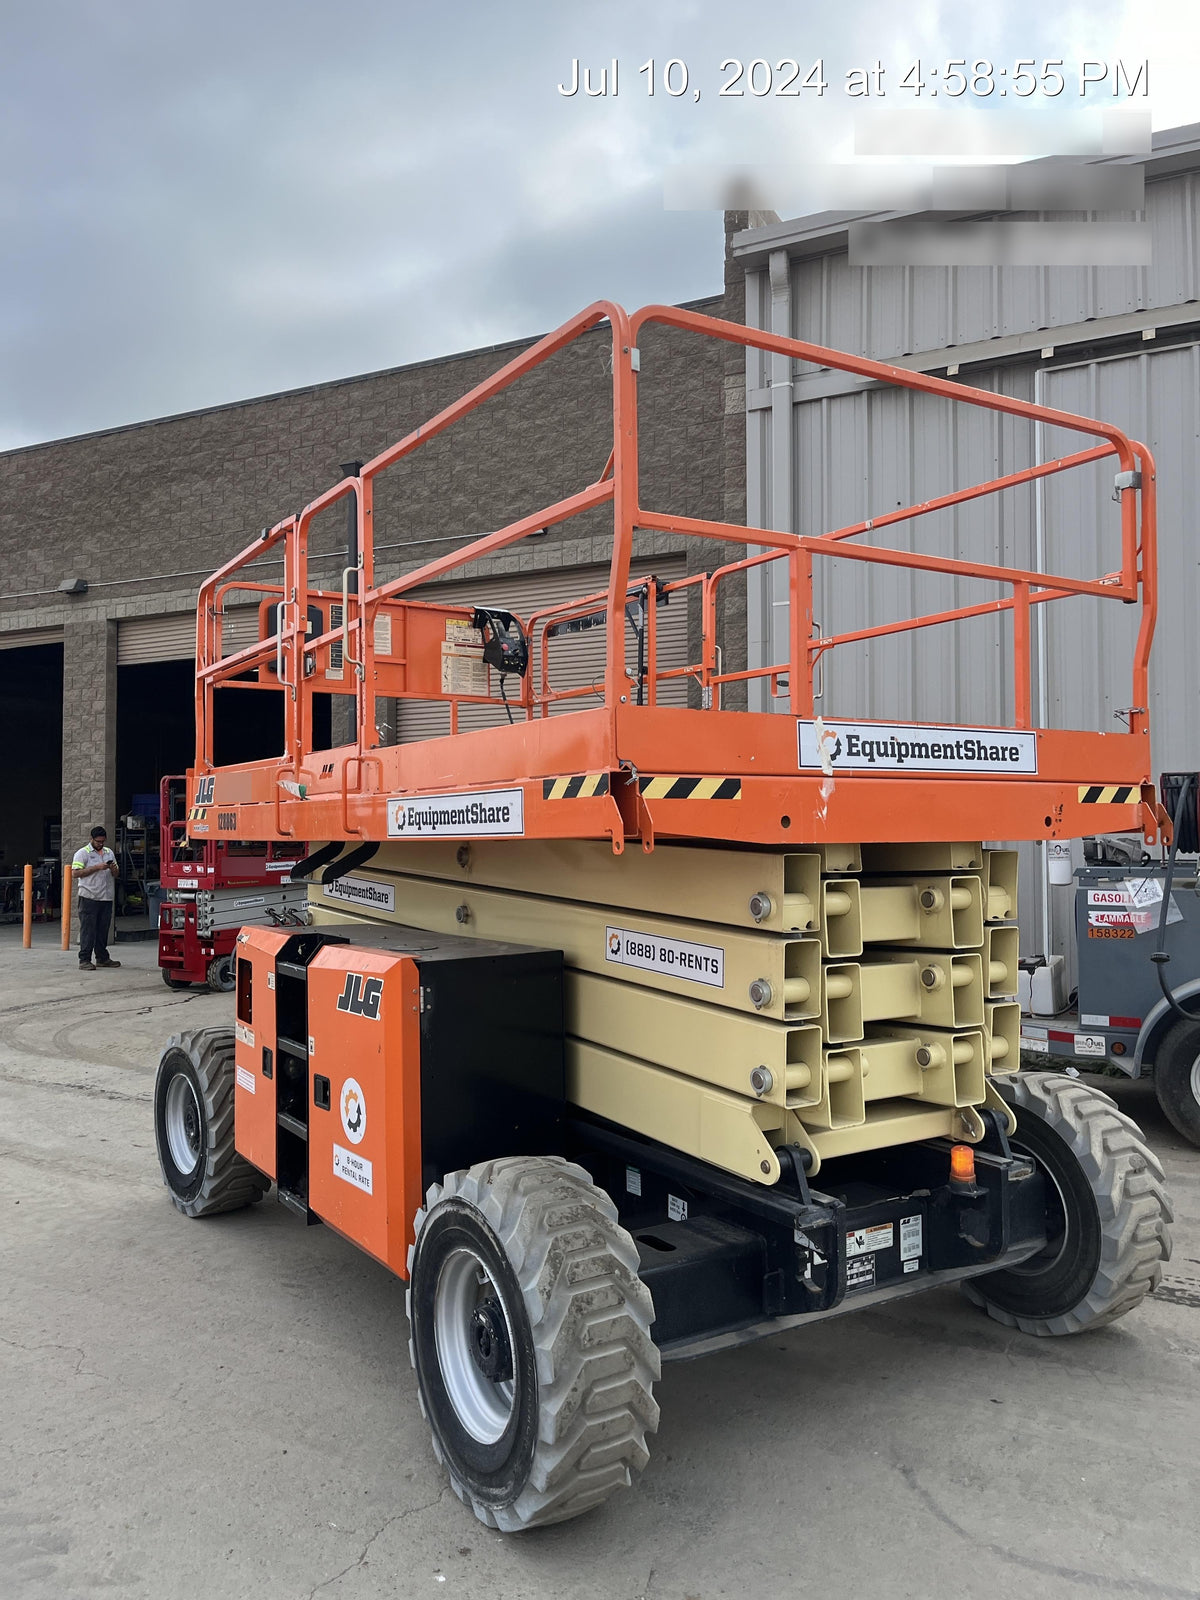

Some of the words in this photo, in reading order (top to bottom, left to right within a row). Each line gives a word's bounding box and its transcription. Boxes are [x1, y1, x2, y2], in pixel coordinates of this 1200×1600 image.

[846, 734, 1020, 763] EquipmentShare
[195, 776, 215, 805] JLG
[408, 803, 510, 831] EquipmentShare
[334, 879, 389, 904] EquipmentShare
[1089, 928, 1135, 939] 158322
[625, 939, 656, 961] (888)
[659, 947, 719, 975] 80-RENTS
[336, 972, 384, 1020] JLG
[342, 1165, 358, 1181] RENTAL
[358, 1174, 370, 1188] RATE
